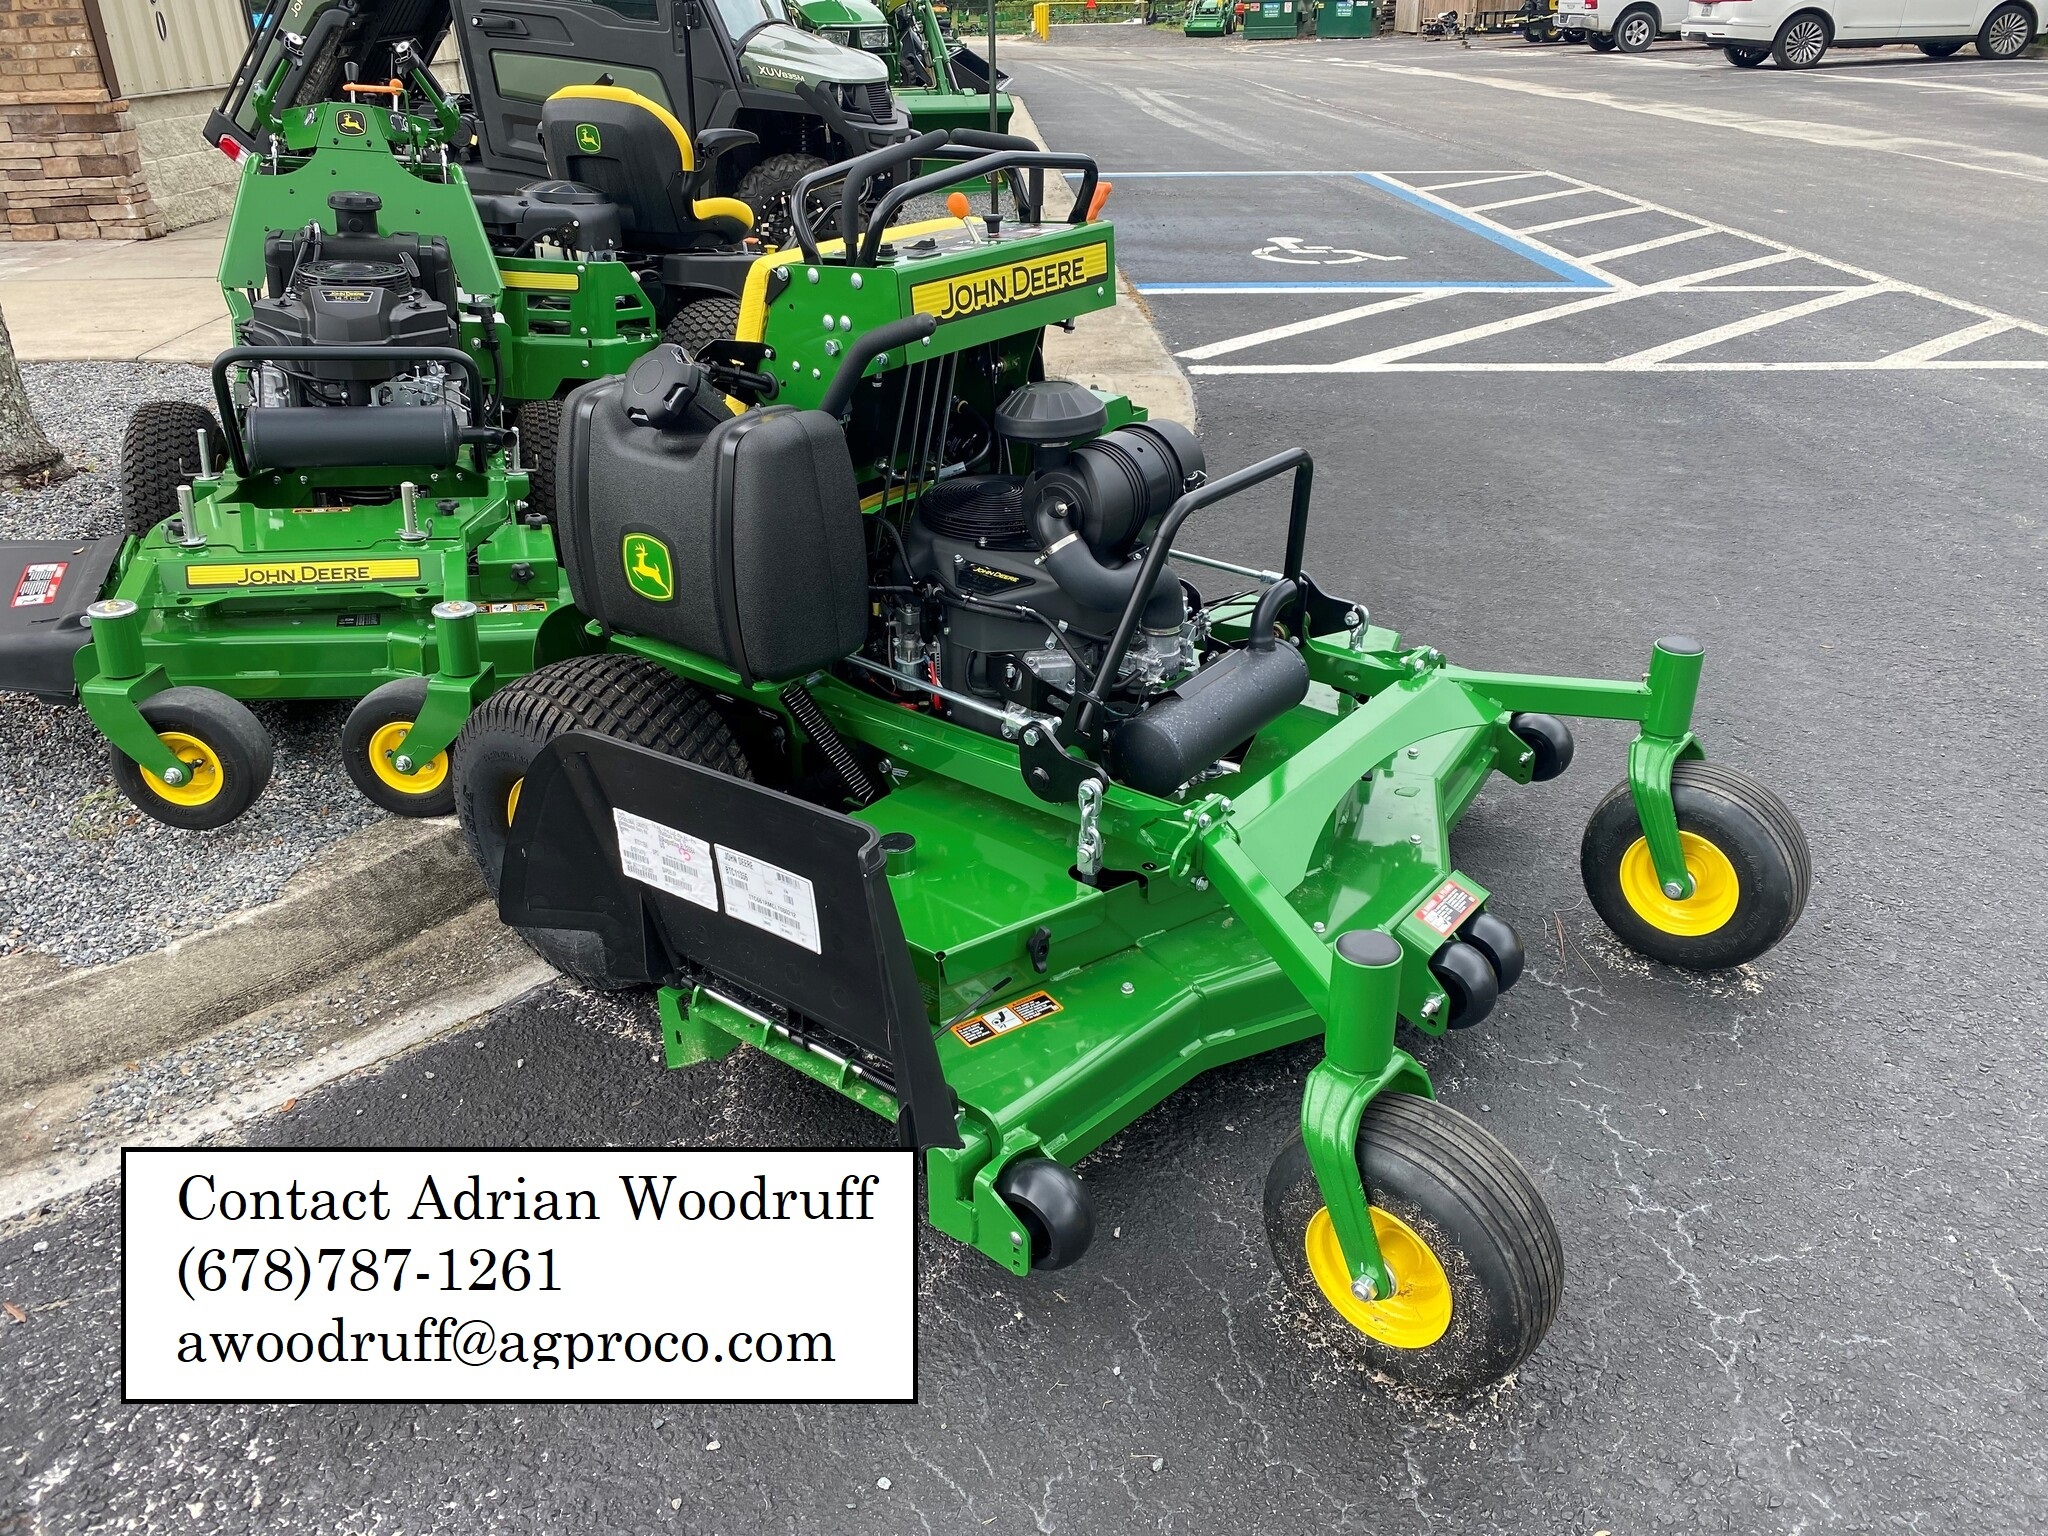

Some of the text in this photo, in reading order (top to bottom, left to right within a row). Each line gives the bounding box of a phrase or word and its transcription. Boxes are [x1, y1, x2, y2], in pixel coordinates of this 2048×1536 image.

[941, 257, 1085, 316] JOHN DEERE
[237, 566, 370, 584] JOHN DEERE
[973, 566, 1020, 583] JOHN DEERE
